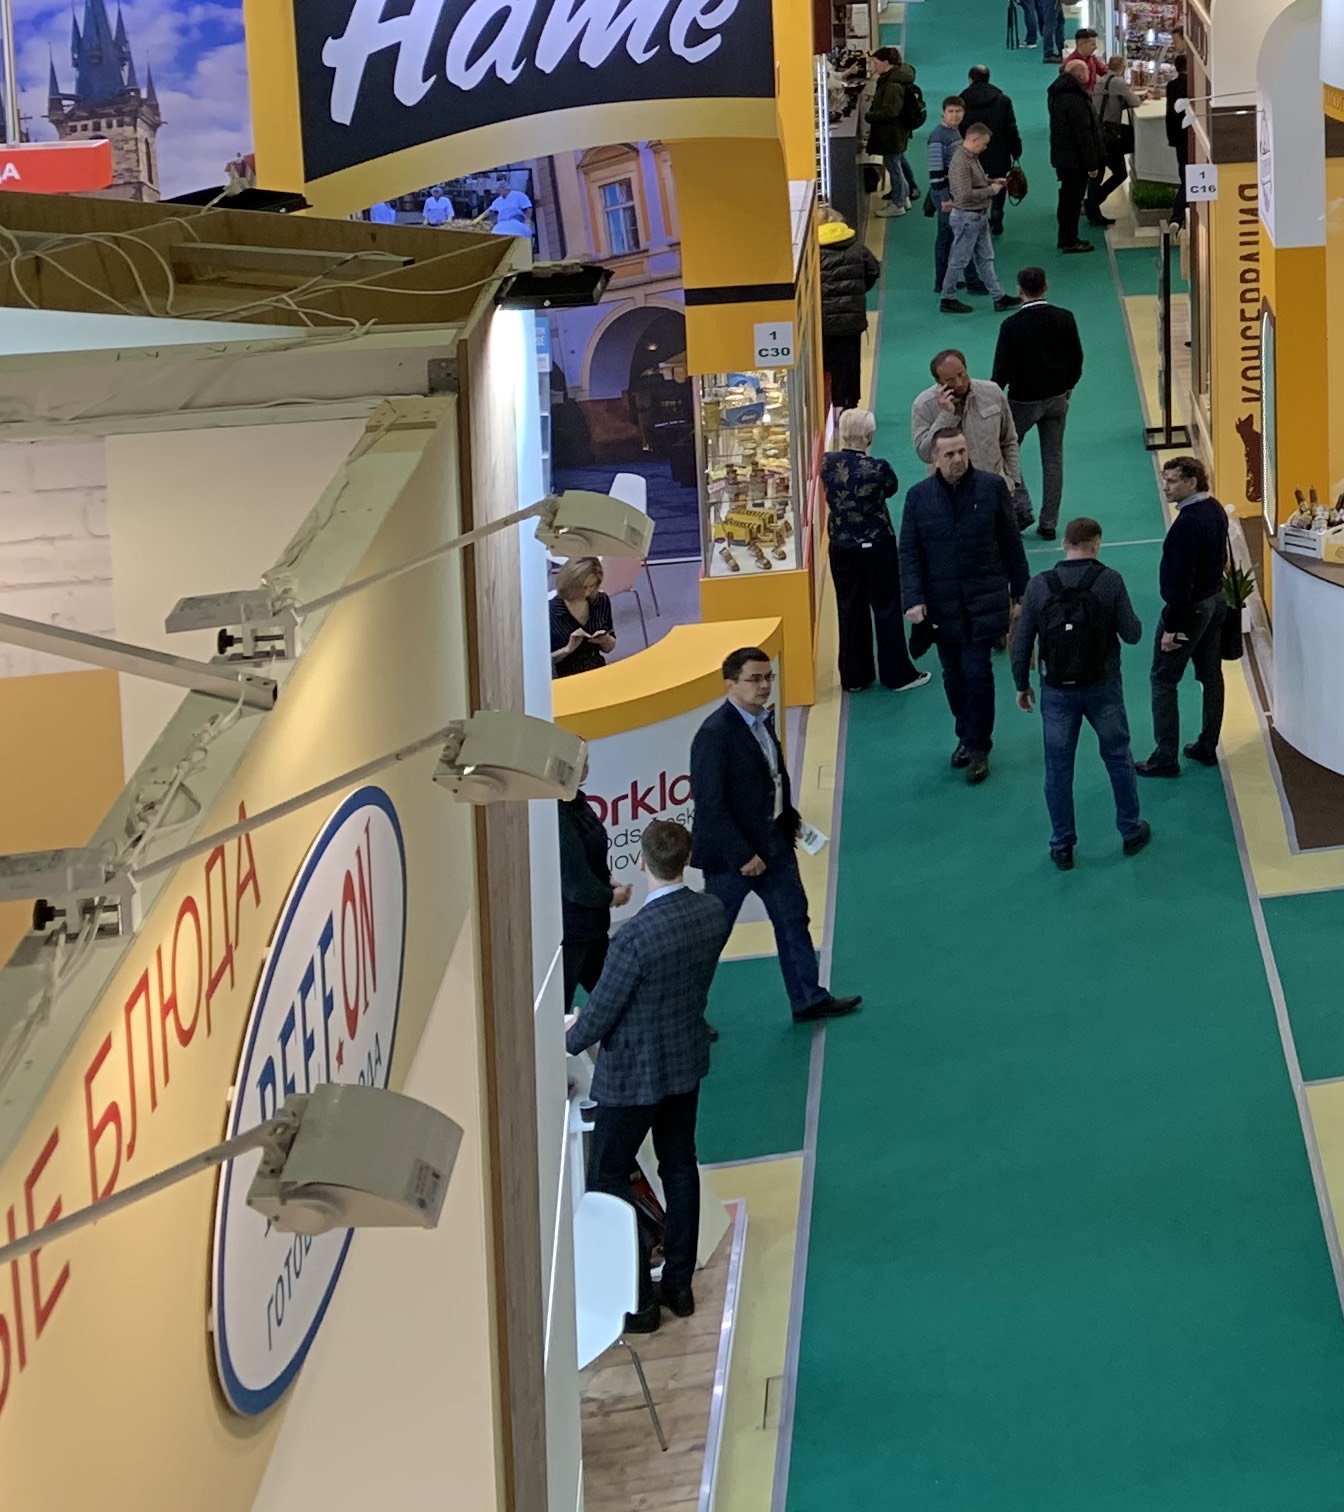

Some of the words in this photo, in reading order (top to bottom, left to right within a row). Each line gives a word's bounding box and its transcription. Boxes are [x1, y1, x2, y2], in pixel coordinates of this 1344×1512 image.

[1190, 184, 1217, 194] C16
[768, 330, 778, 341] 1
[758, 346, 791, 358] C30
[83, 800, 262, 1226] БЛЮДА
